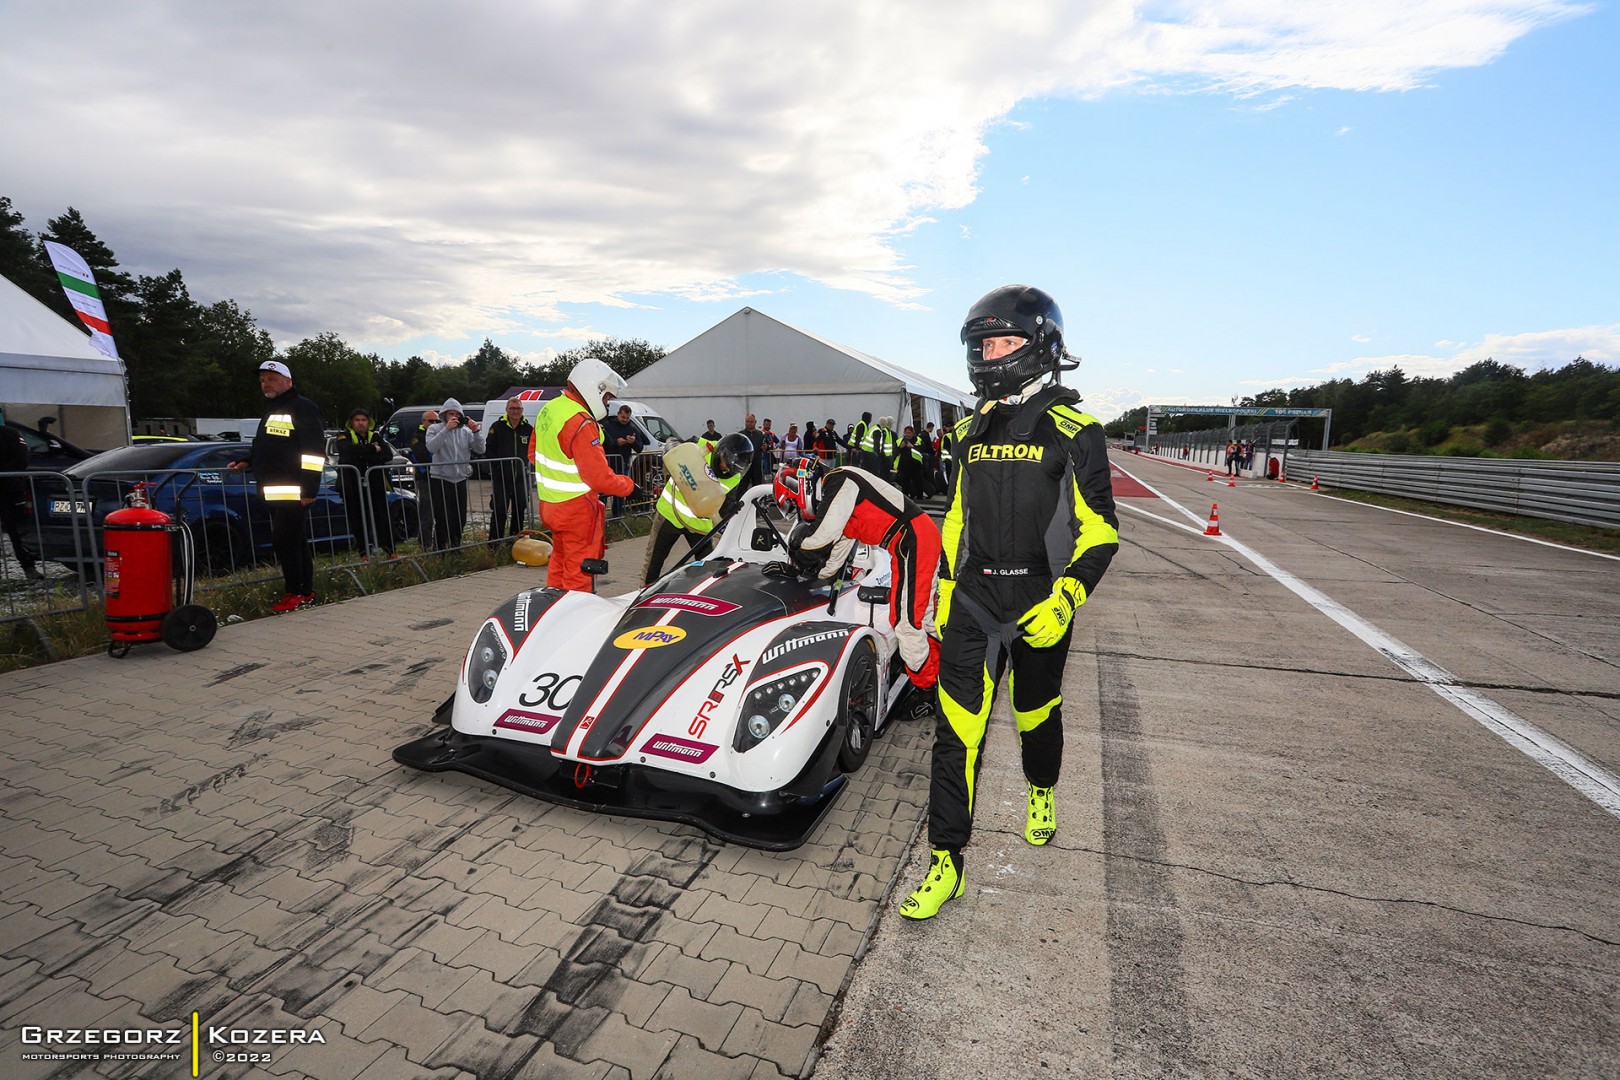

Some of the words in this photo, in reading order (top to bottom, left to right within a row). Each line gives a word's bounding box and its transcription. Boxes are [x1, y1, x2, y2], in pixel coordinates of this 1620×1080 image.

[1059, 420, 1079, 434] OMP
[968, 443, 1045, 464] ELTRON
[999, 567, 1029, 576] GLASSE
[1052, 606, 1067, 627] OMP
